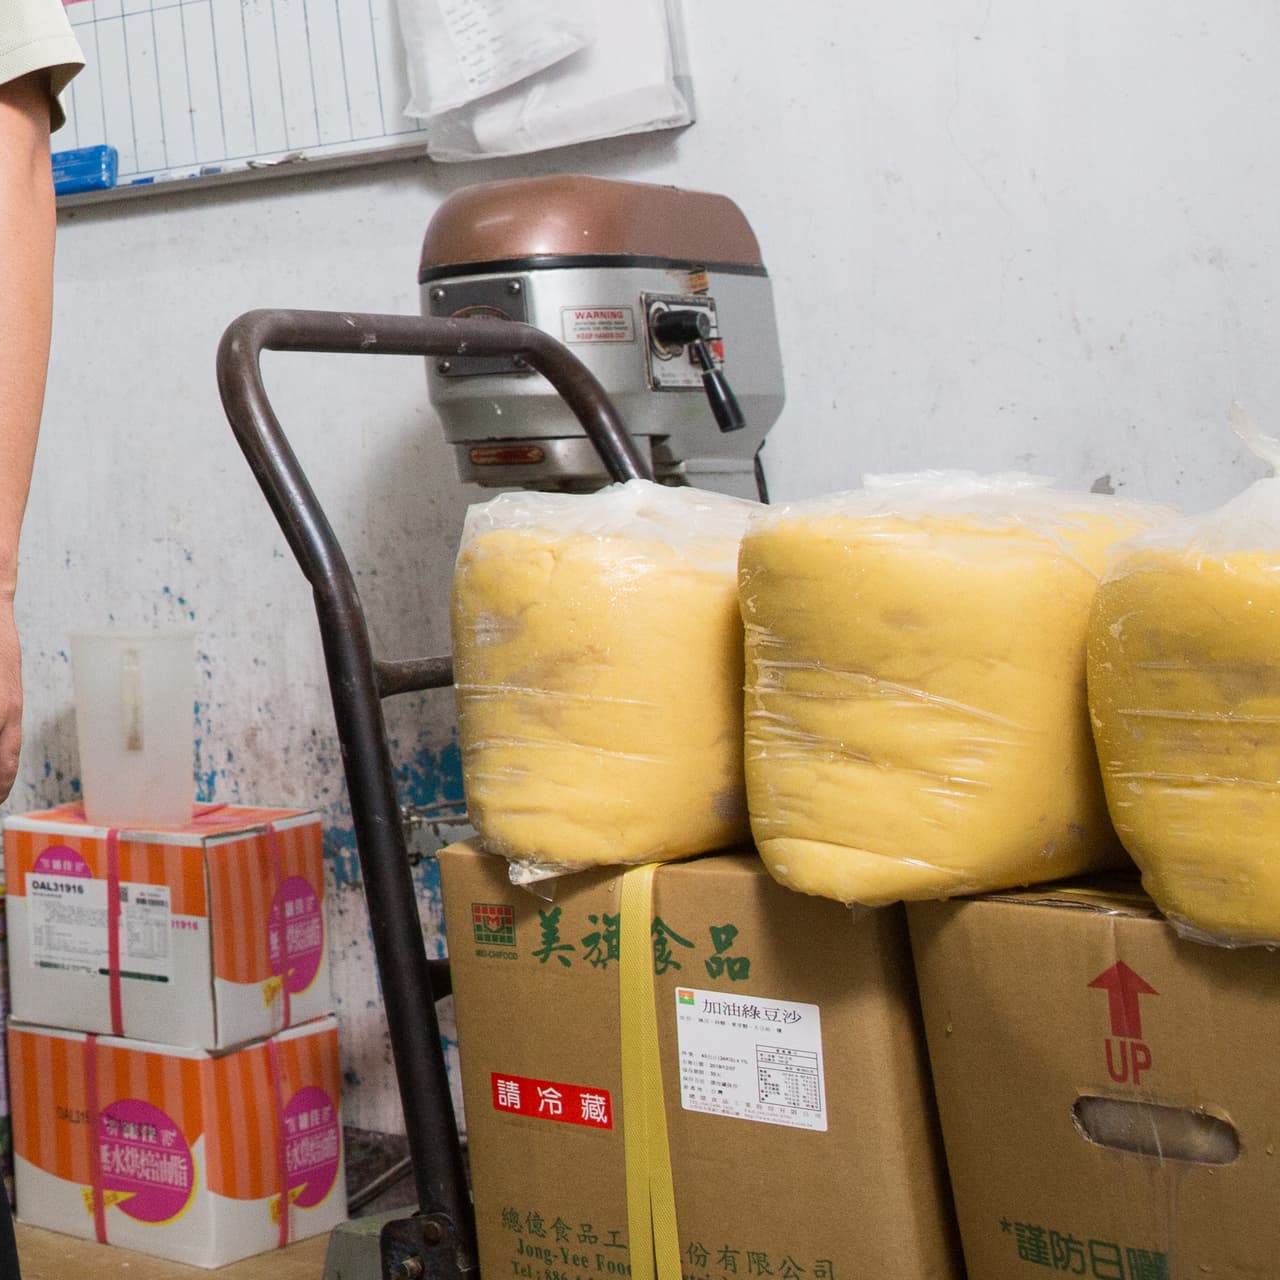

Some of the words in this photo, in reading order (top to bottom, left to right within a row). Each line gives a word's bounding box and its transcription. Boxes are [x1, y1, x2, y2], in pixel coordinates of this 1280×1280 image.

[575, 310, 624, 320] WARNING
[702, 998, 802, 1025] 加油綠豆沙
[1104, 1038, 1153, 1086] UP
[496, 1078, 608, 1125] 請冷藏
[516, 1238, 589, 1266] Jong-Yee
